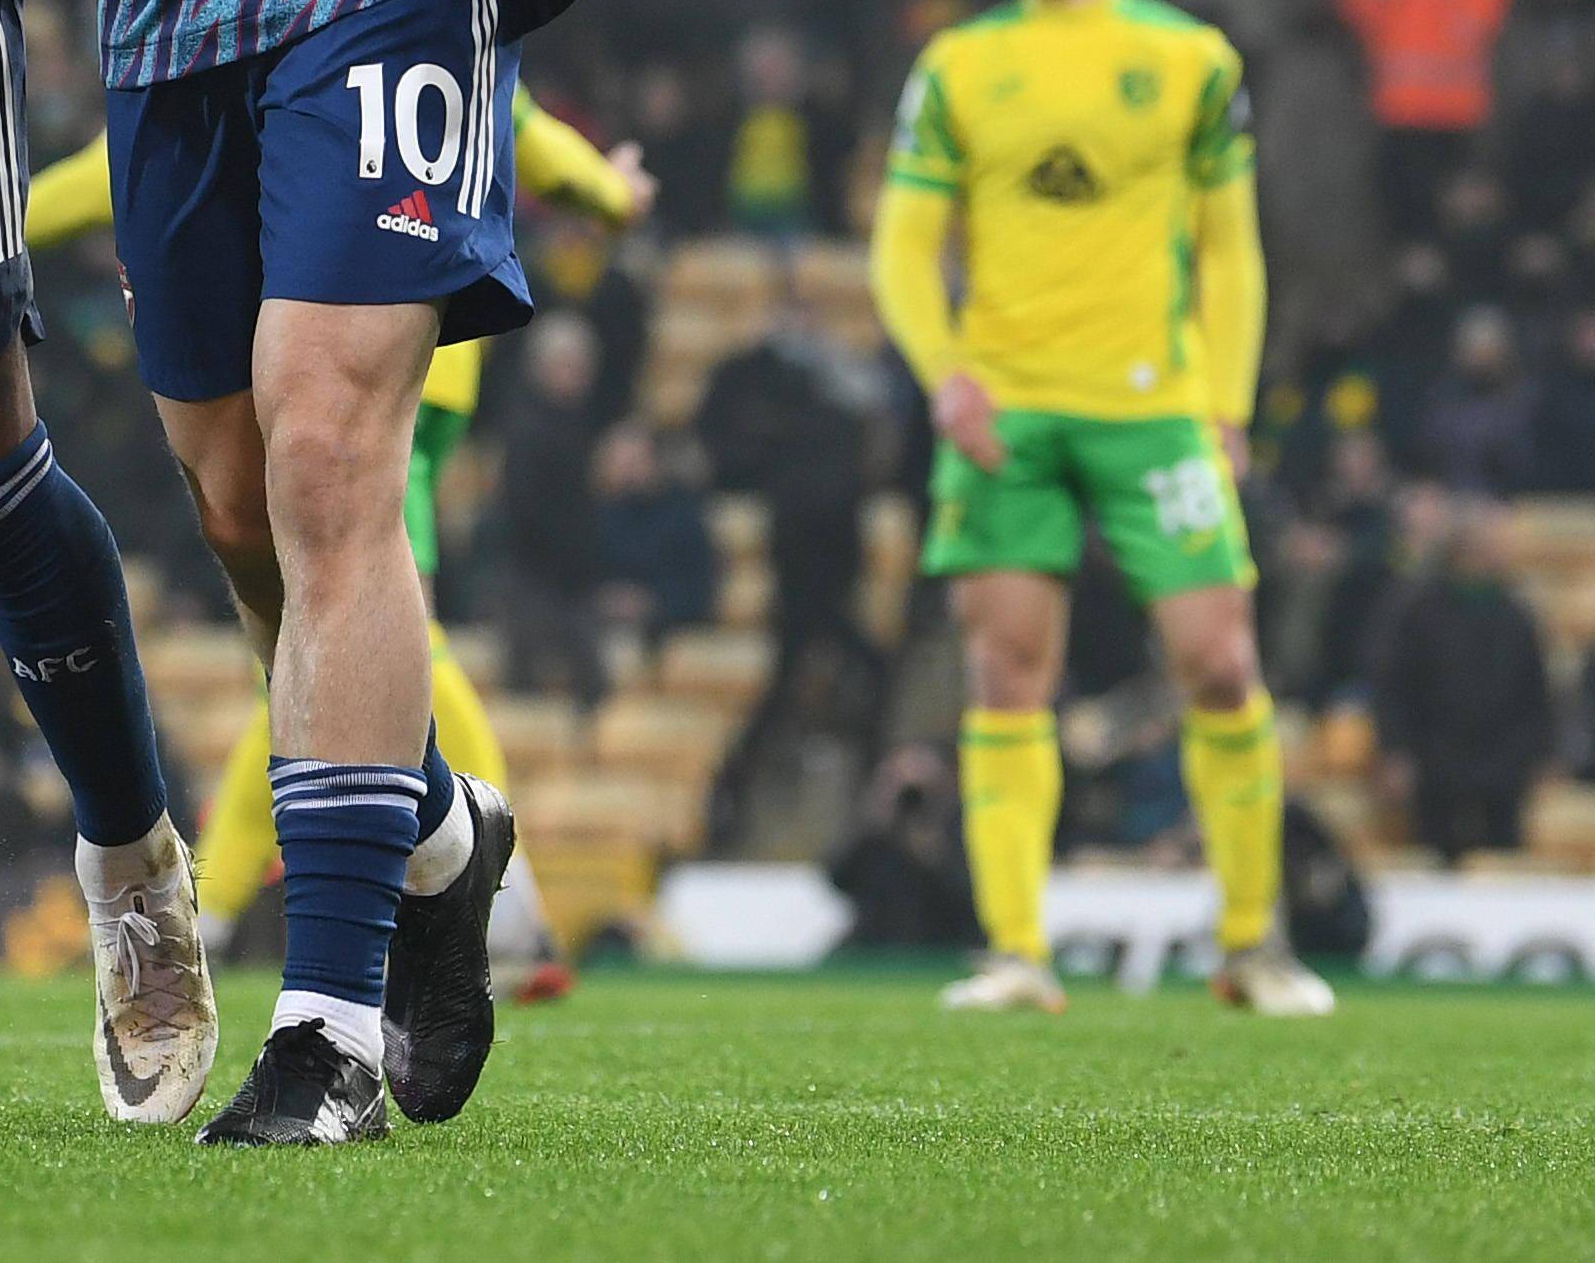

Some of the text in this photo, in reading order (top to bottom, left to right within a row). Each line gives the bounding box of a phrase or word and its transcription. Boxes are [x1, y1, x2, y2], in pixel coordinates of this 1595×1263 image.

[346, 62, 464, 185] 10
[376, 214, 439, 242] adidas
[12, 644, 99, 683] AFC
